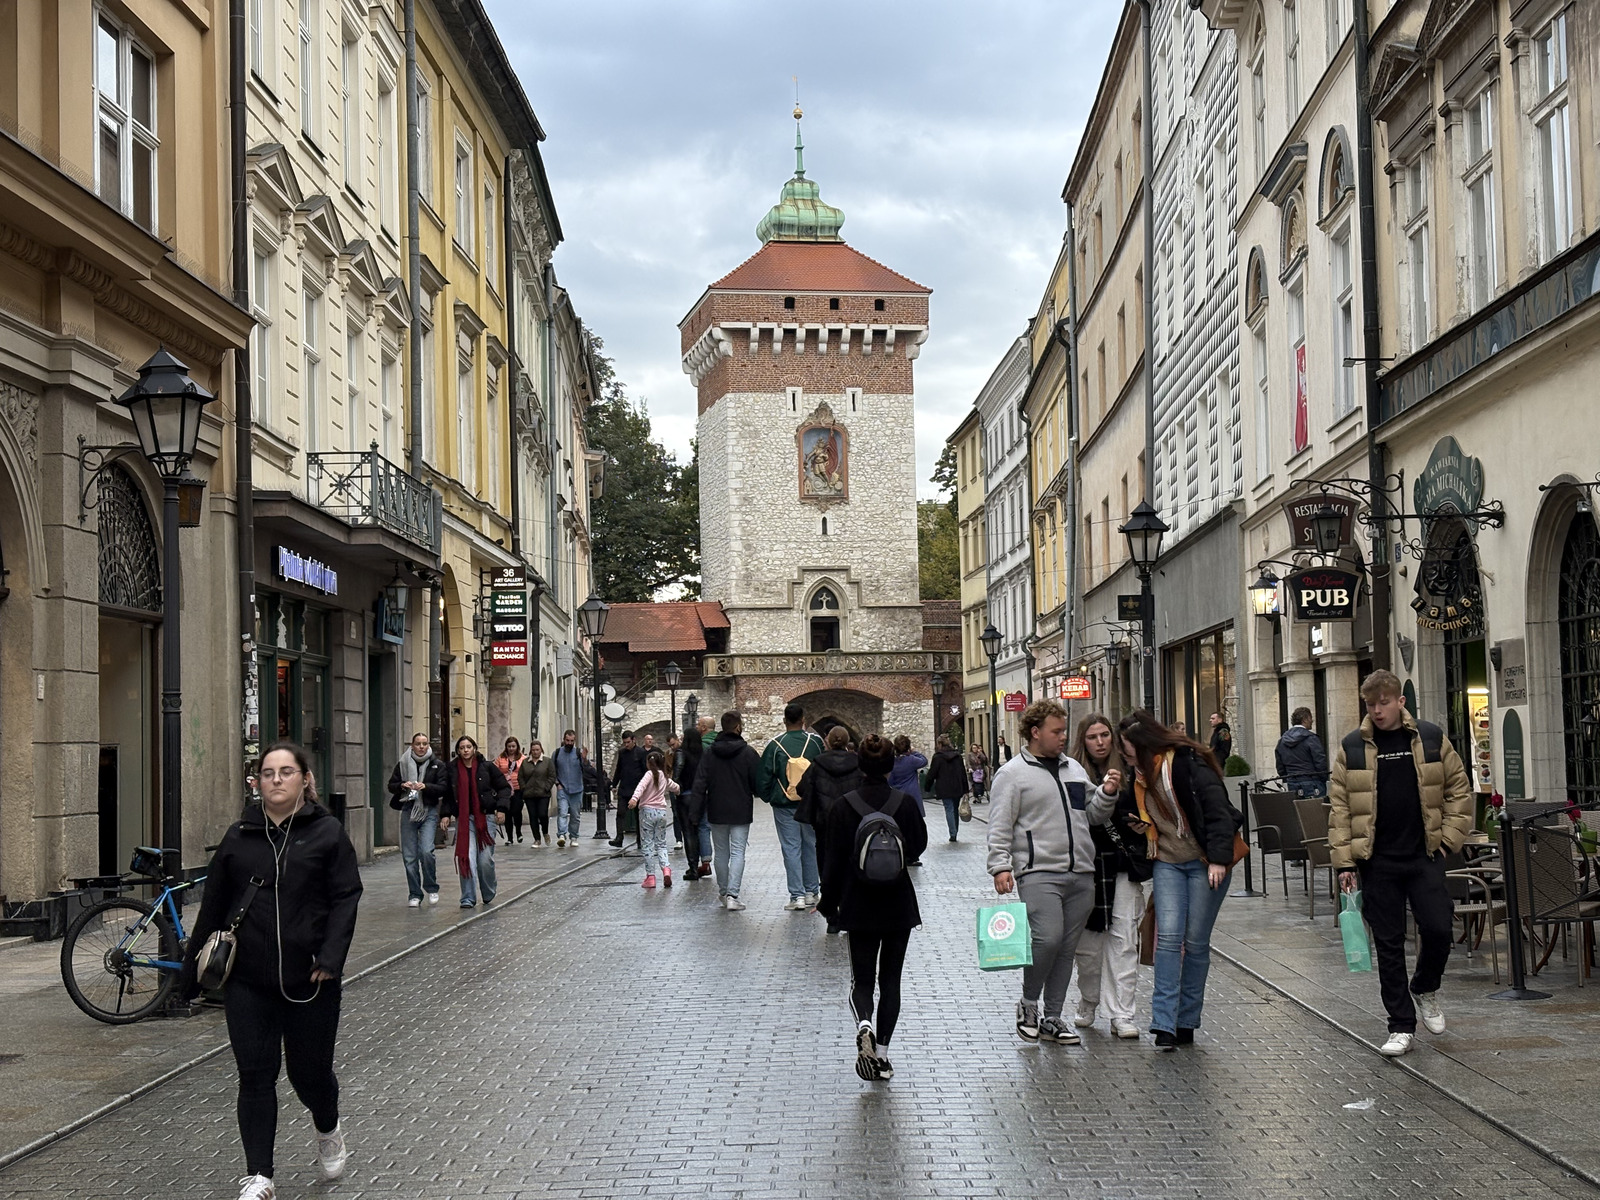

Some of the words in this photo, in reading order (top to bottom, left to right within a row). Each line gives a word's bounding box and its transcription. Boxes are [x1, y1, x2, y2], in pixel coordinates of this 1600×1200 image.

[1430, 455, 1459, 478] KAWIARNIA
[1437, 473, 1472, 512] MICHALIKA
[502, 568, 515, 578] 36
[1300, 588, 1350, 607] PUB
[494, 624, 525, 632] TATTOO
[1062, 684, 1089, 692] KEBAB
